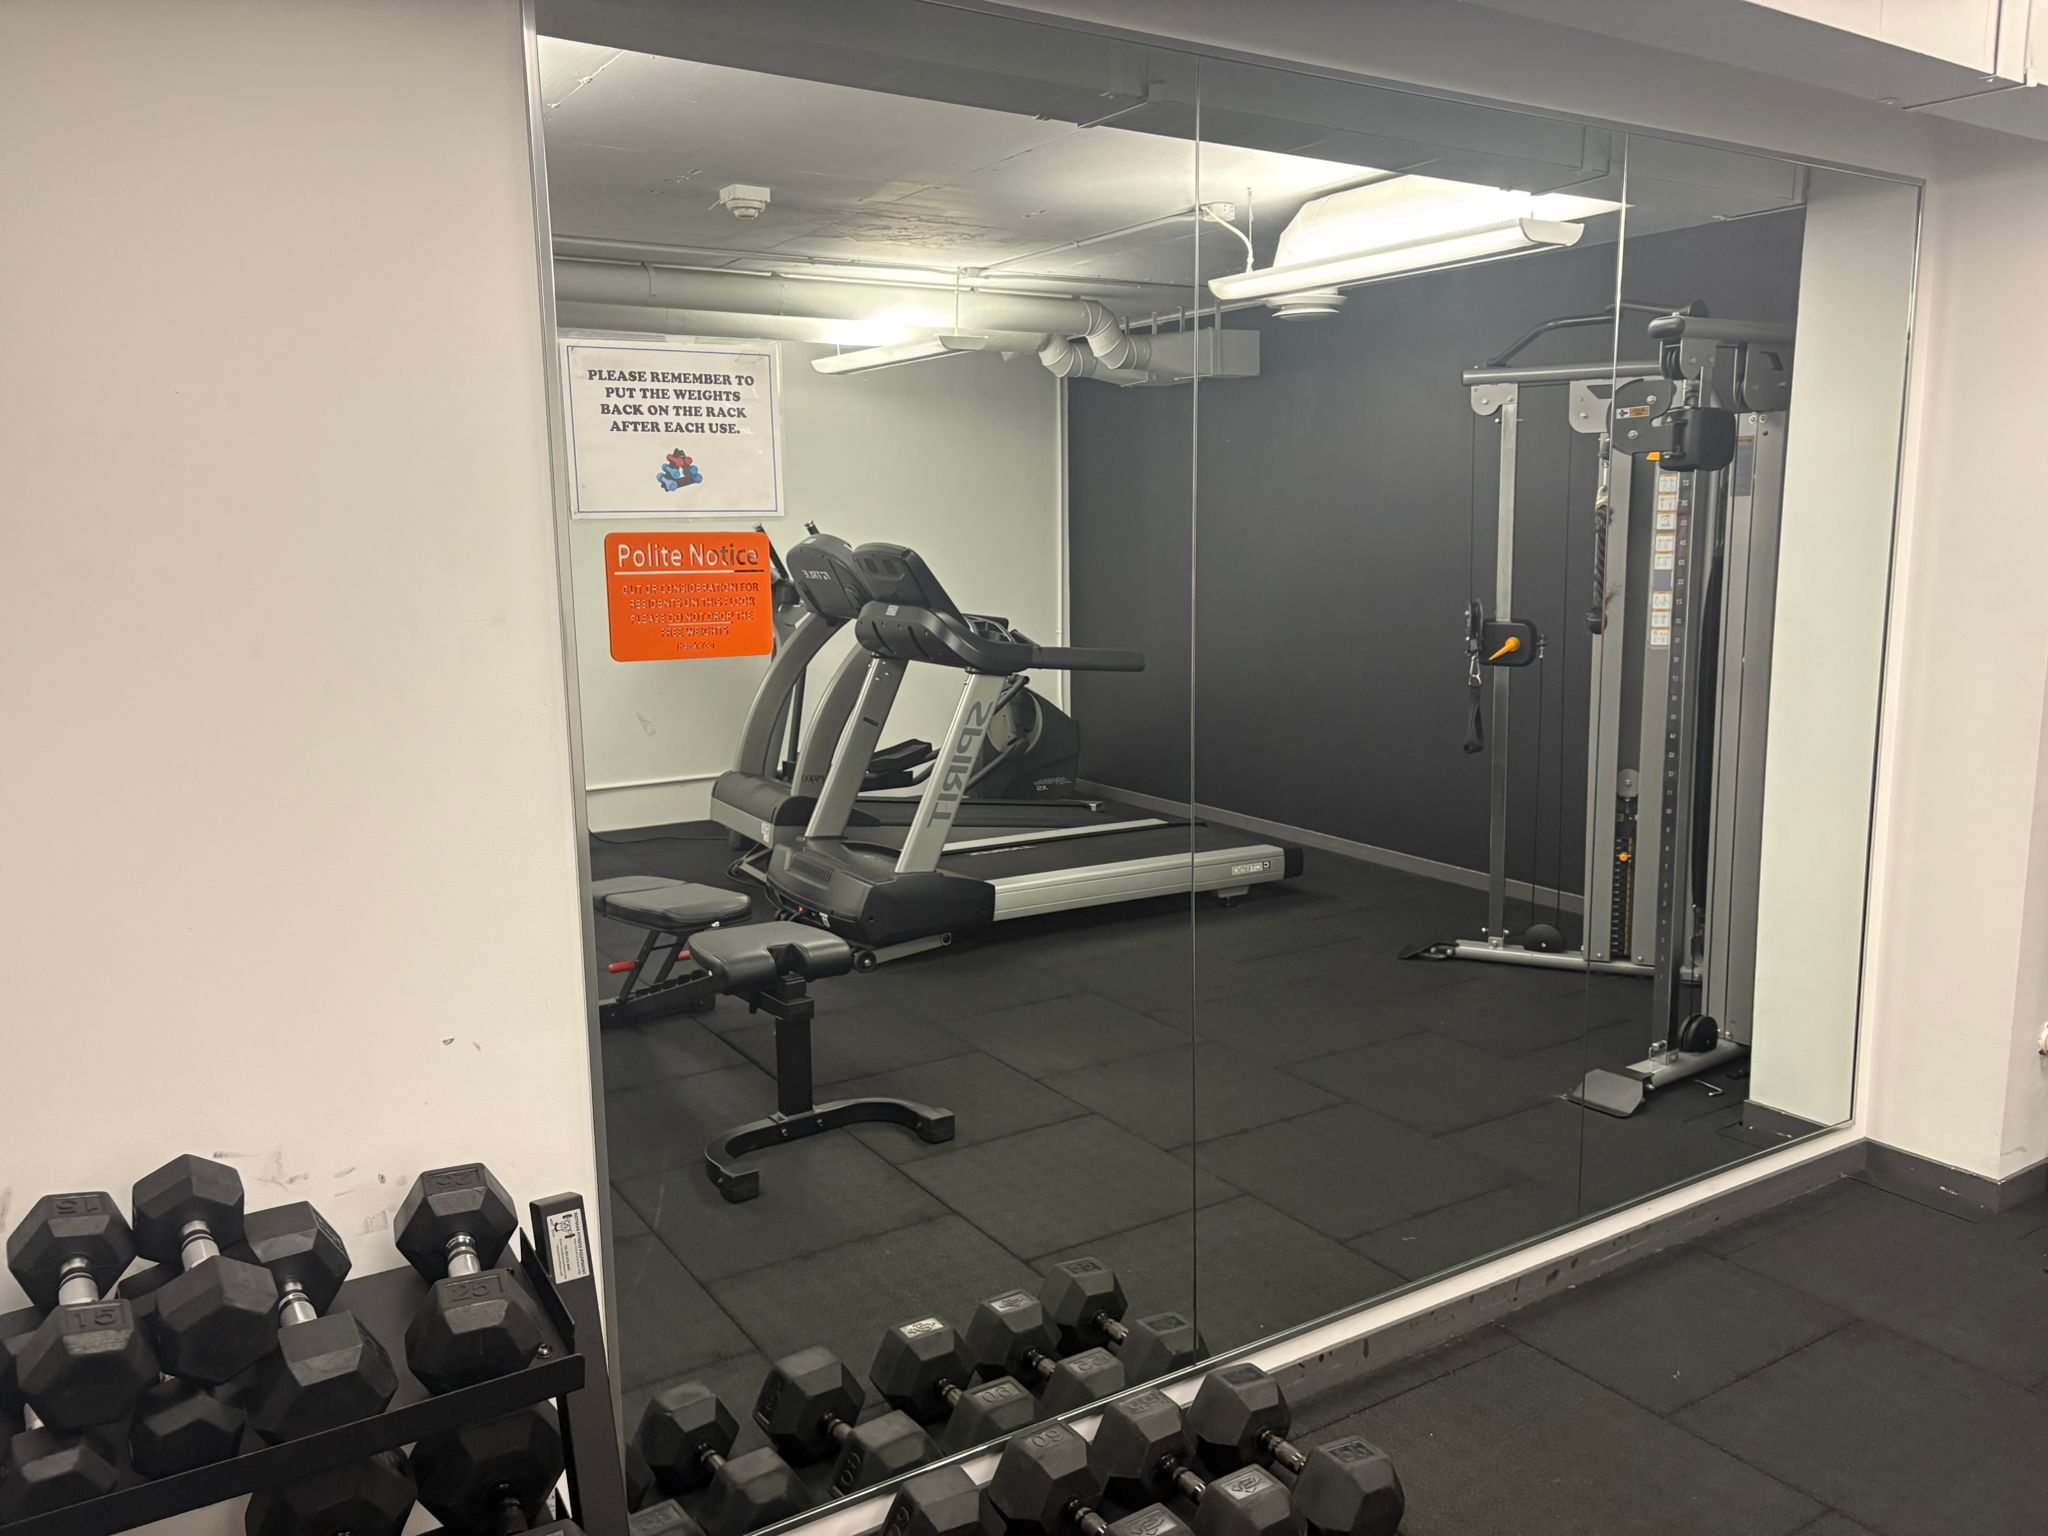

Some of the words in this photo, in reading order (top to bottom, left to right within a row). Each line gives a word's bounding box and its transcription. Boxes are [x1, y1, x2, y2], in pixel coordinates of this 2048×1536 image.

[588, 370, 647, 383] PLEASE
[650, 371, 732, 385] REMEMBER
[735, 375, 754, 386] TO
[605, 387, 636, 399] PUT
[640, 388, 670, 400] THE
[673, 389, 741, 402] WEIGHTS
[600, 404, 644, 416] BACK
[647, 405, 669, 416] ON
[673, 406, 703, 417] THE
[705, 406, 747, 418] RACK
[610, 421, 661, 433] AFTER
[664, 422, 705, 433] EACH
[708, 423, 741, 434] USE.
[618, 543, 683, 568] Polite
[689, 543, 759, 567] Notice
[623, 584, 642, 595] OUT
[646, 584, 657, 594] OF
[661, 583, 738, 594] CONSIDERATION
[740, 582, 759, 592] FOR
[629, 598, 682, 609] RESIDENTS
[685, 597, 699, 608] ON
[701, 597, 722, 607] THIS
[724, 596, 756, 606] FLOOR
[630, 613, 666, 624] PLEASE
[668, 613, 684, 623] DO
[686, 612, 706, 622] NOT
[707, 611, 734, 621] DROP
[735, 610, 754, 620] THE
[661, 627, 683, 638] FREE
[686, 626, 729, 637] WEIGHTS
[56, 1200, 98, 1215] 15
[452, 1284, 489, 1301] 25
[74, 1308, 117, 1328] 15
